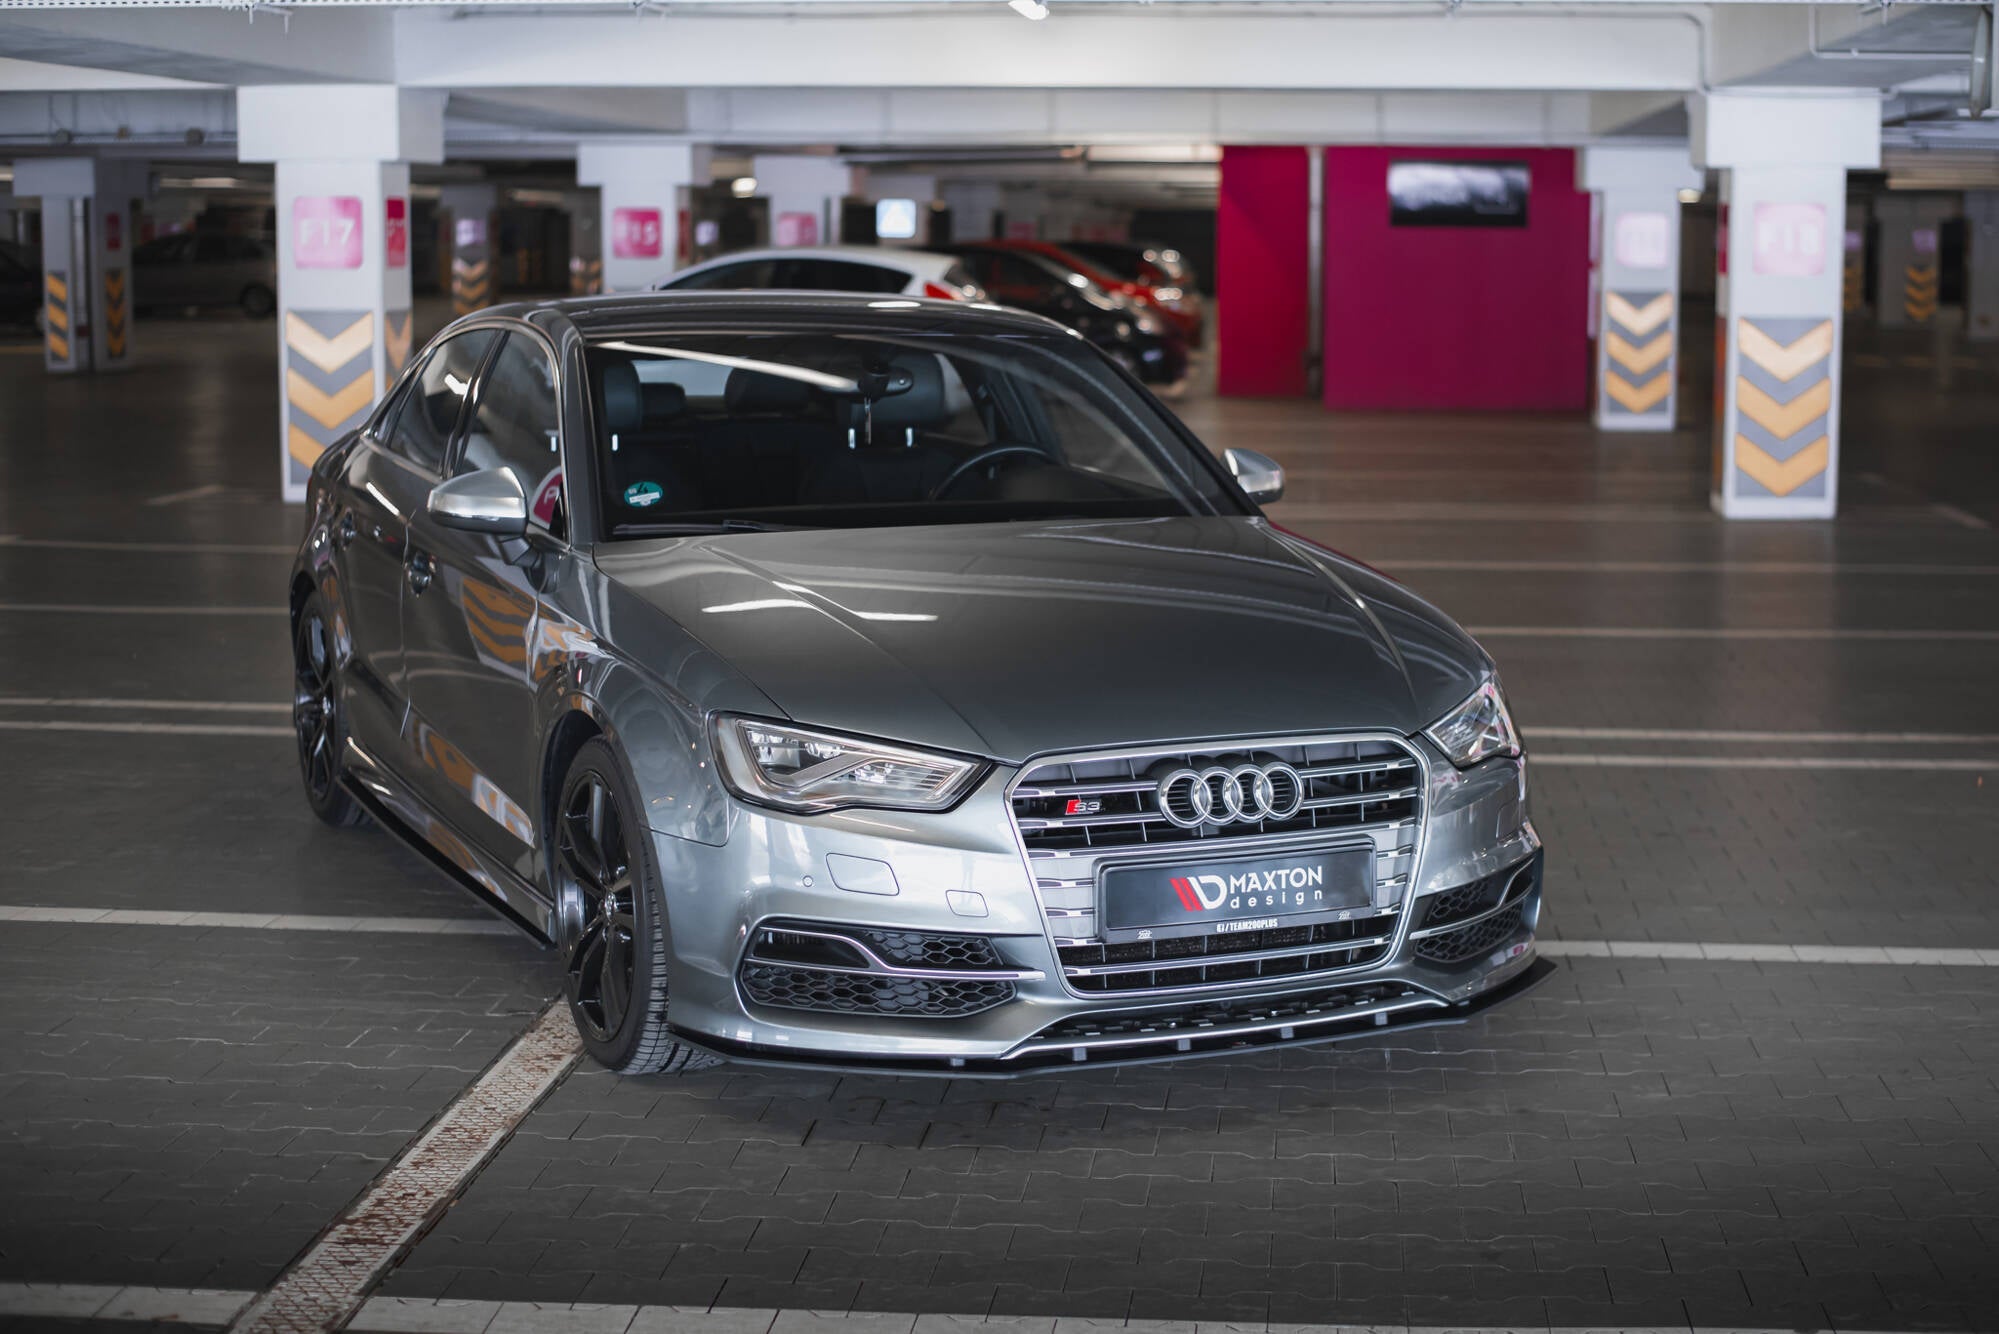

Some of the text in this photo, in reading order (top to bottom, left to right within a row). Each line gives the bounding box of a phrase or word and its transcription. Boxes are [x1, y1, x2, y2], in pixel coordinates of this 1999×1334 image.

[300, 218, 356, 246] F17
[1072, 800, 1101, 812] S3
[1229, 865, 1323, 894] MAXTON
[1229, 889, 1323, 909] design
